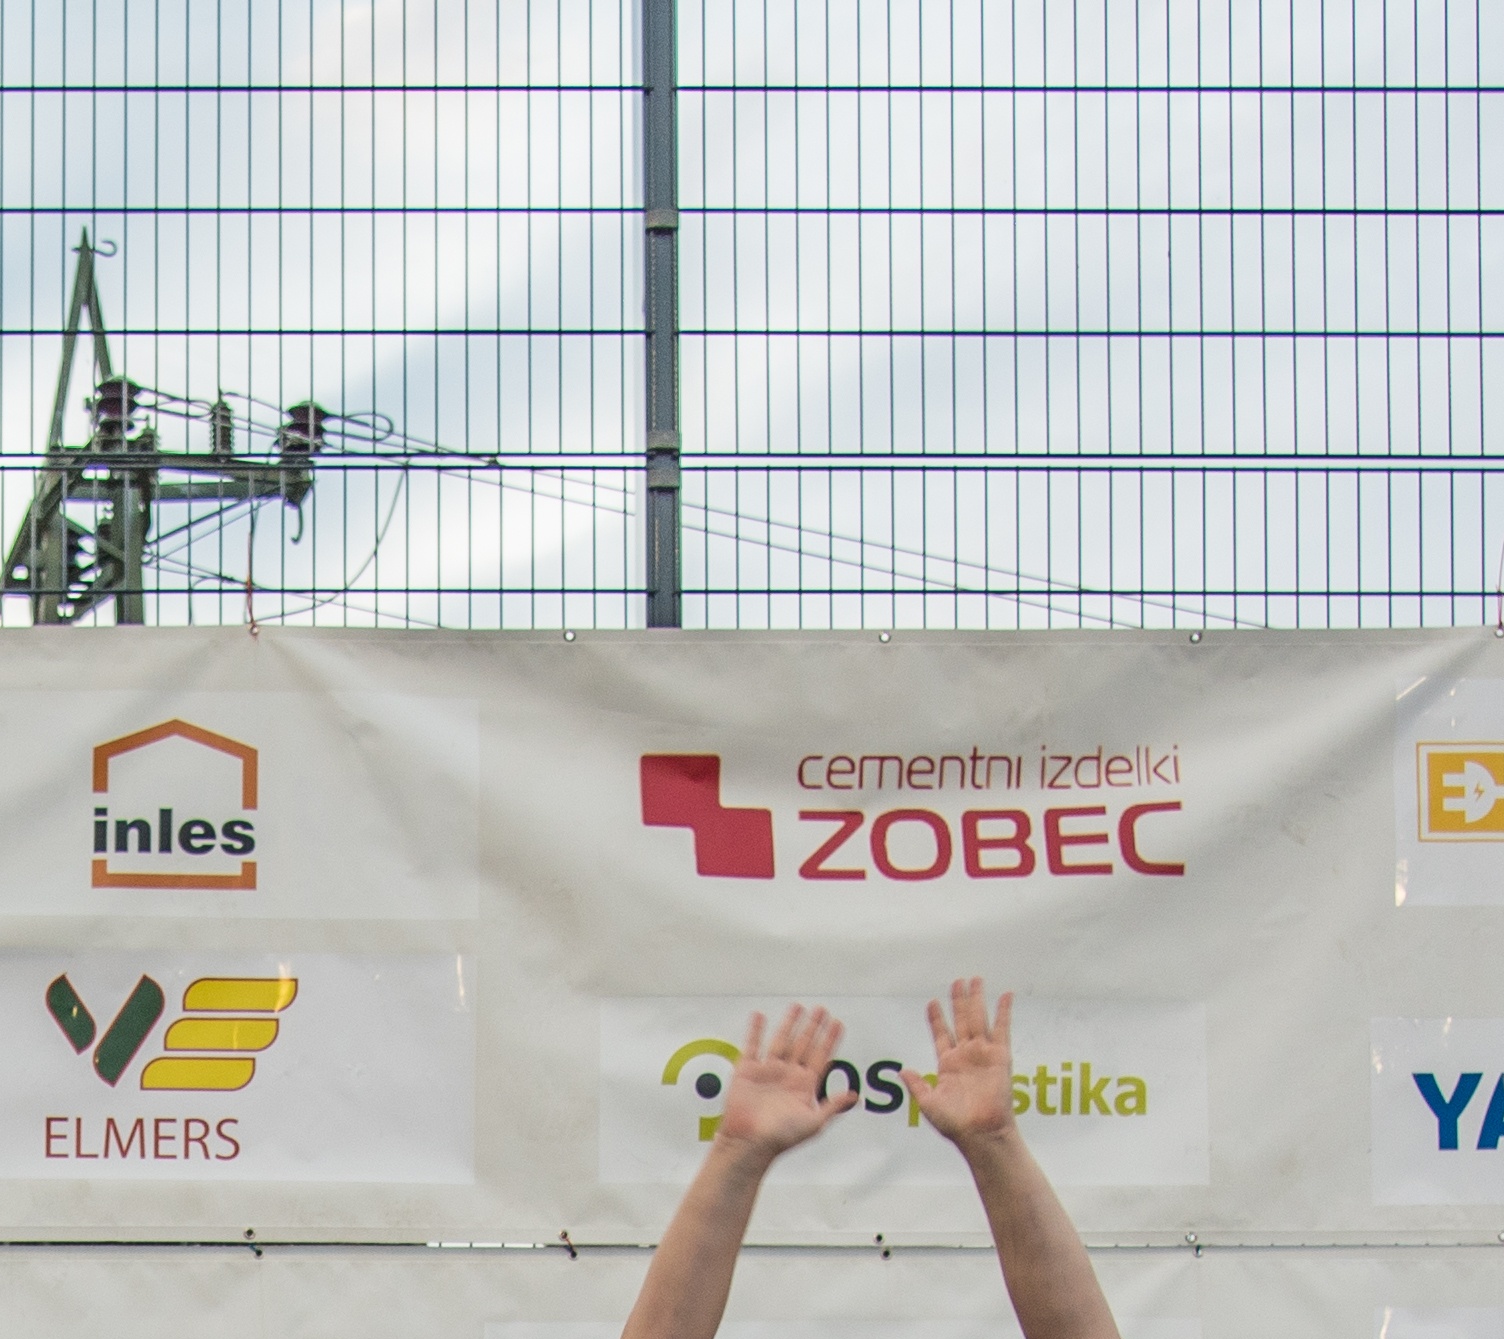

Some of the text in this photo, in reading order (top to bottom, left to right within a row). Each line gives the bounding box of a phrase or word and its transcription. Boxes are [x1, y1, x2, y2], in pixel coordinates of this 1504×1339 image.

[796, 745, 1181, 791] cementni izdelki
[92, 807, 257, 856] inles
[798, 802, 1186, 882] ZOBEC
[43, 1117, 242, 1162] ELMERS
